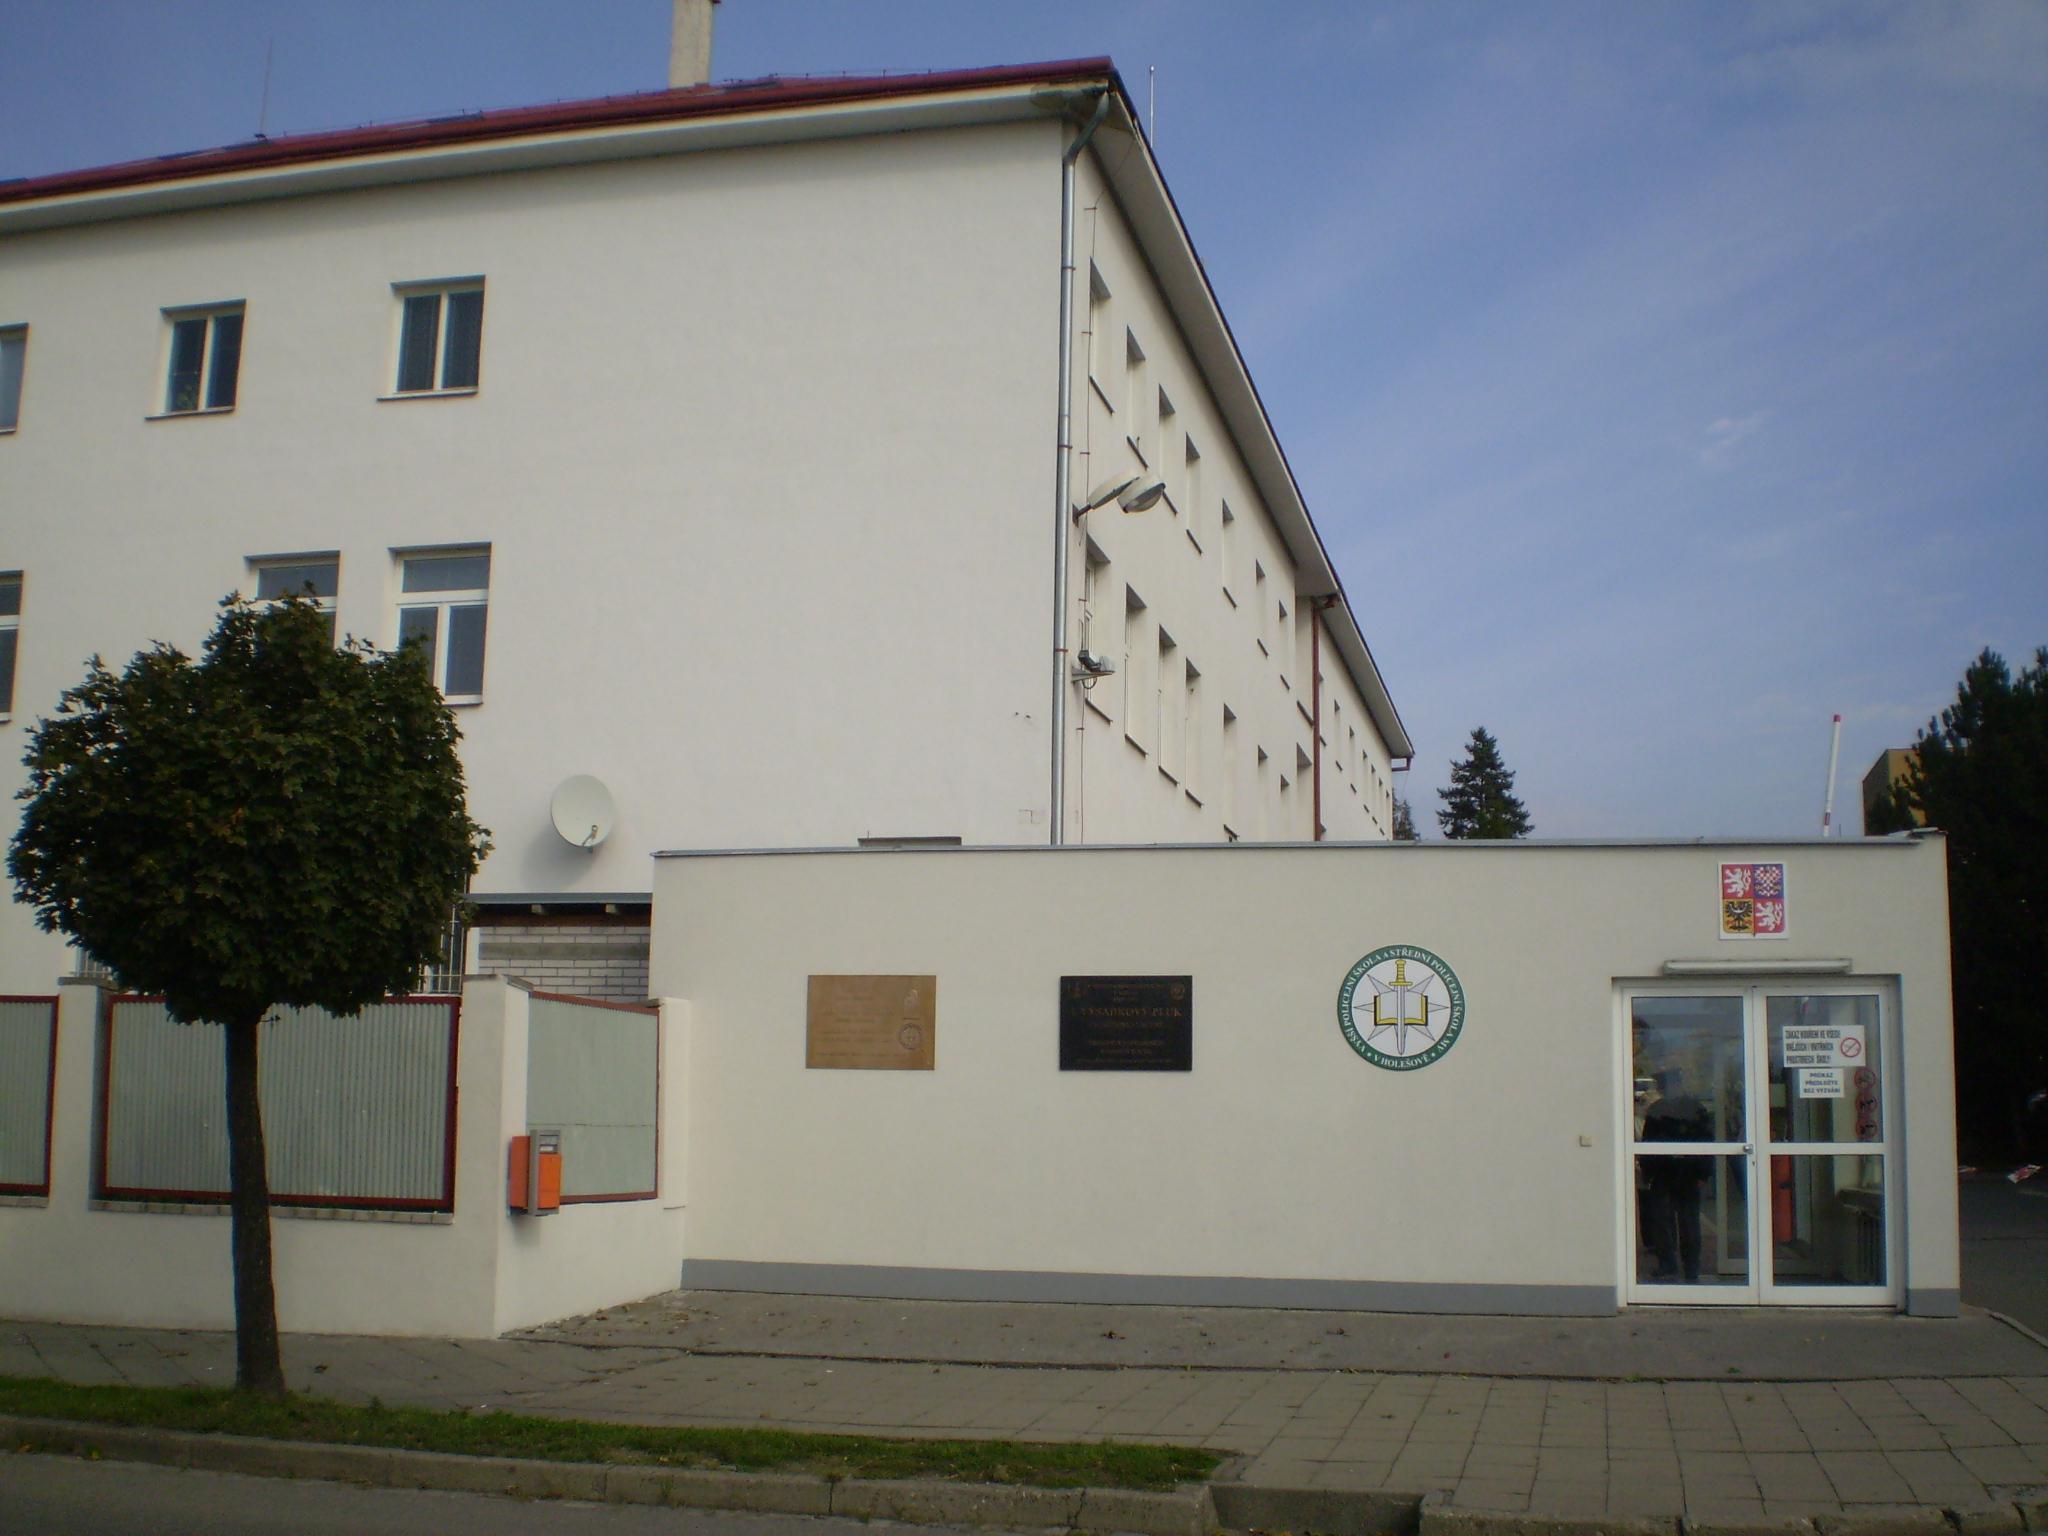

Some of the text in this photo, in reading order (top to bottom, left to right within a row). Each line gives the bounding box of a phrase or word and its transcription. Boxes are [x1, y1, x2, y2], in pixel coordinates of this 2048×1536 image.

[1353, 955, 1382, 977] ŠKOLA
[1390, 947, 1431, 963] STŘEDNÍ
[1431, 960, 1461, 1005] POLICEJNÍ
[1446, 1005, 1463, 1037] ŠKOLA
[1373, 1053, 1430, 1068] V HOLEŠOVĚ
